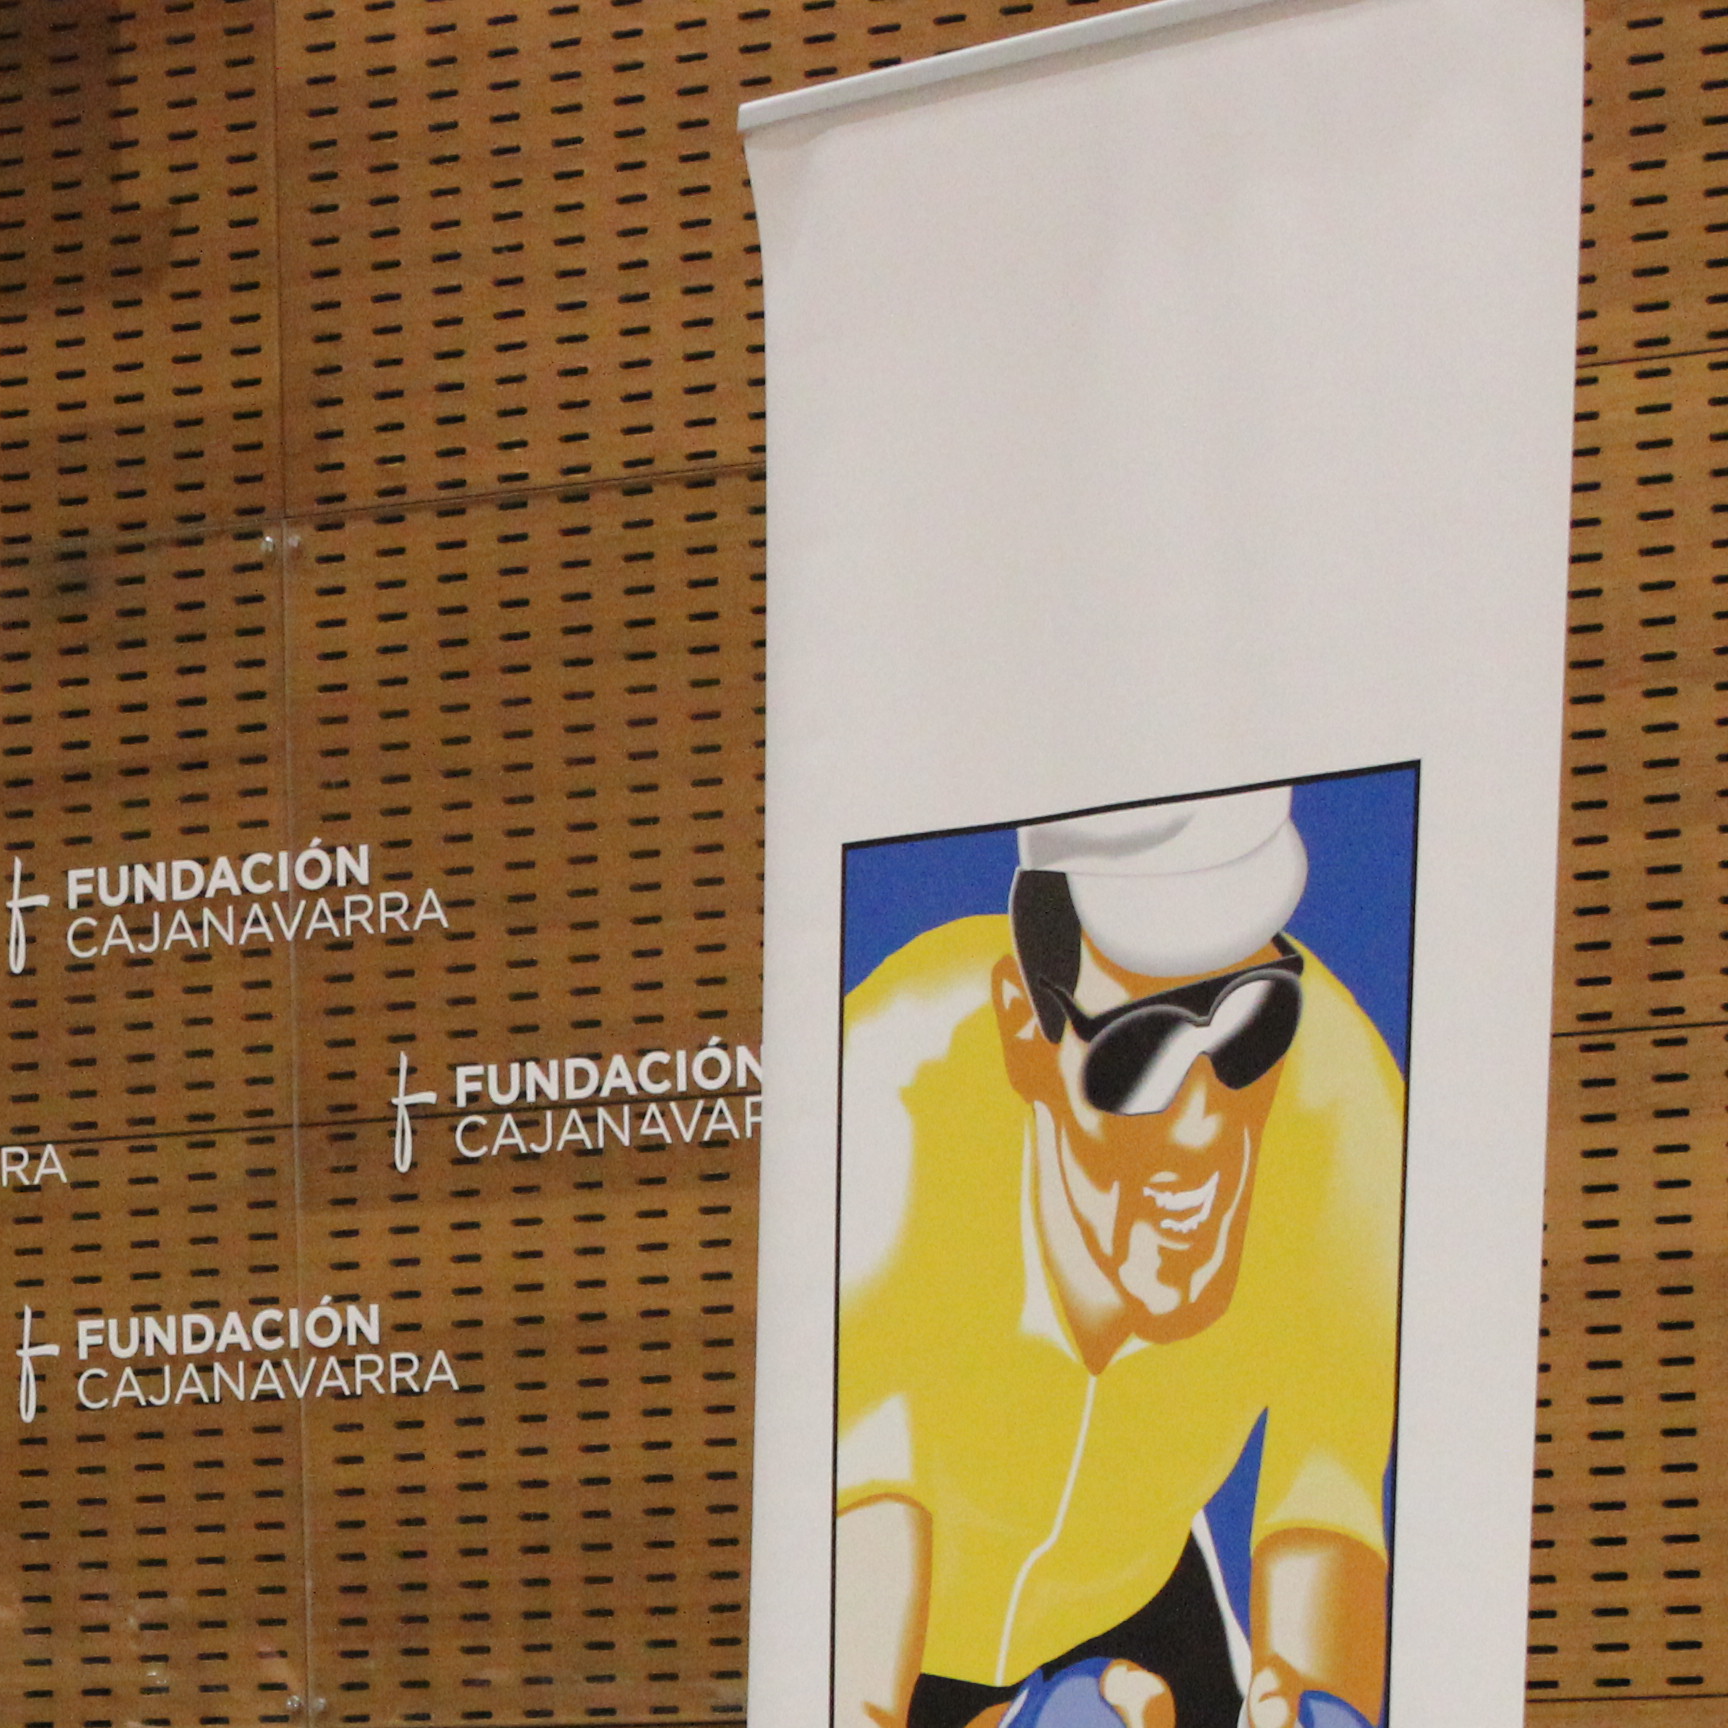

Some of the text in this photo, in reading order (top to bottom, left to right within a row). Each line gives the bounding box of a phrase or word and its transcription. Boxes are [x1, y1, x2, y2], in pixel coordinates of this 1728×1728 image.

[68, 837, 369, 909] FUNDACIÓN
[67, 888, 448, 958] CAJANAVARRA
[78, 1295, 379, 1359] FUNDACIÓN
[78, 1350, 458, 1408] CAJANAVARRA
